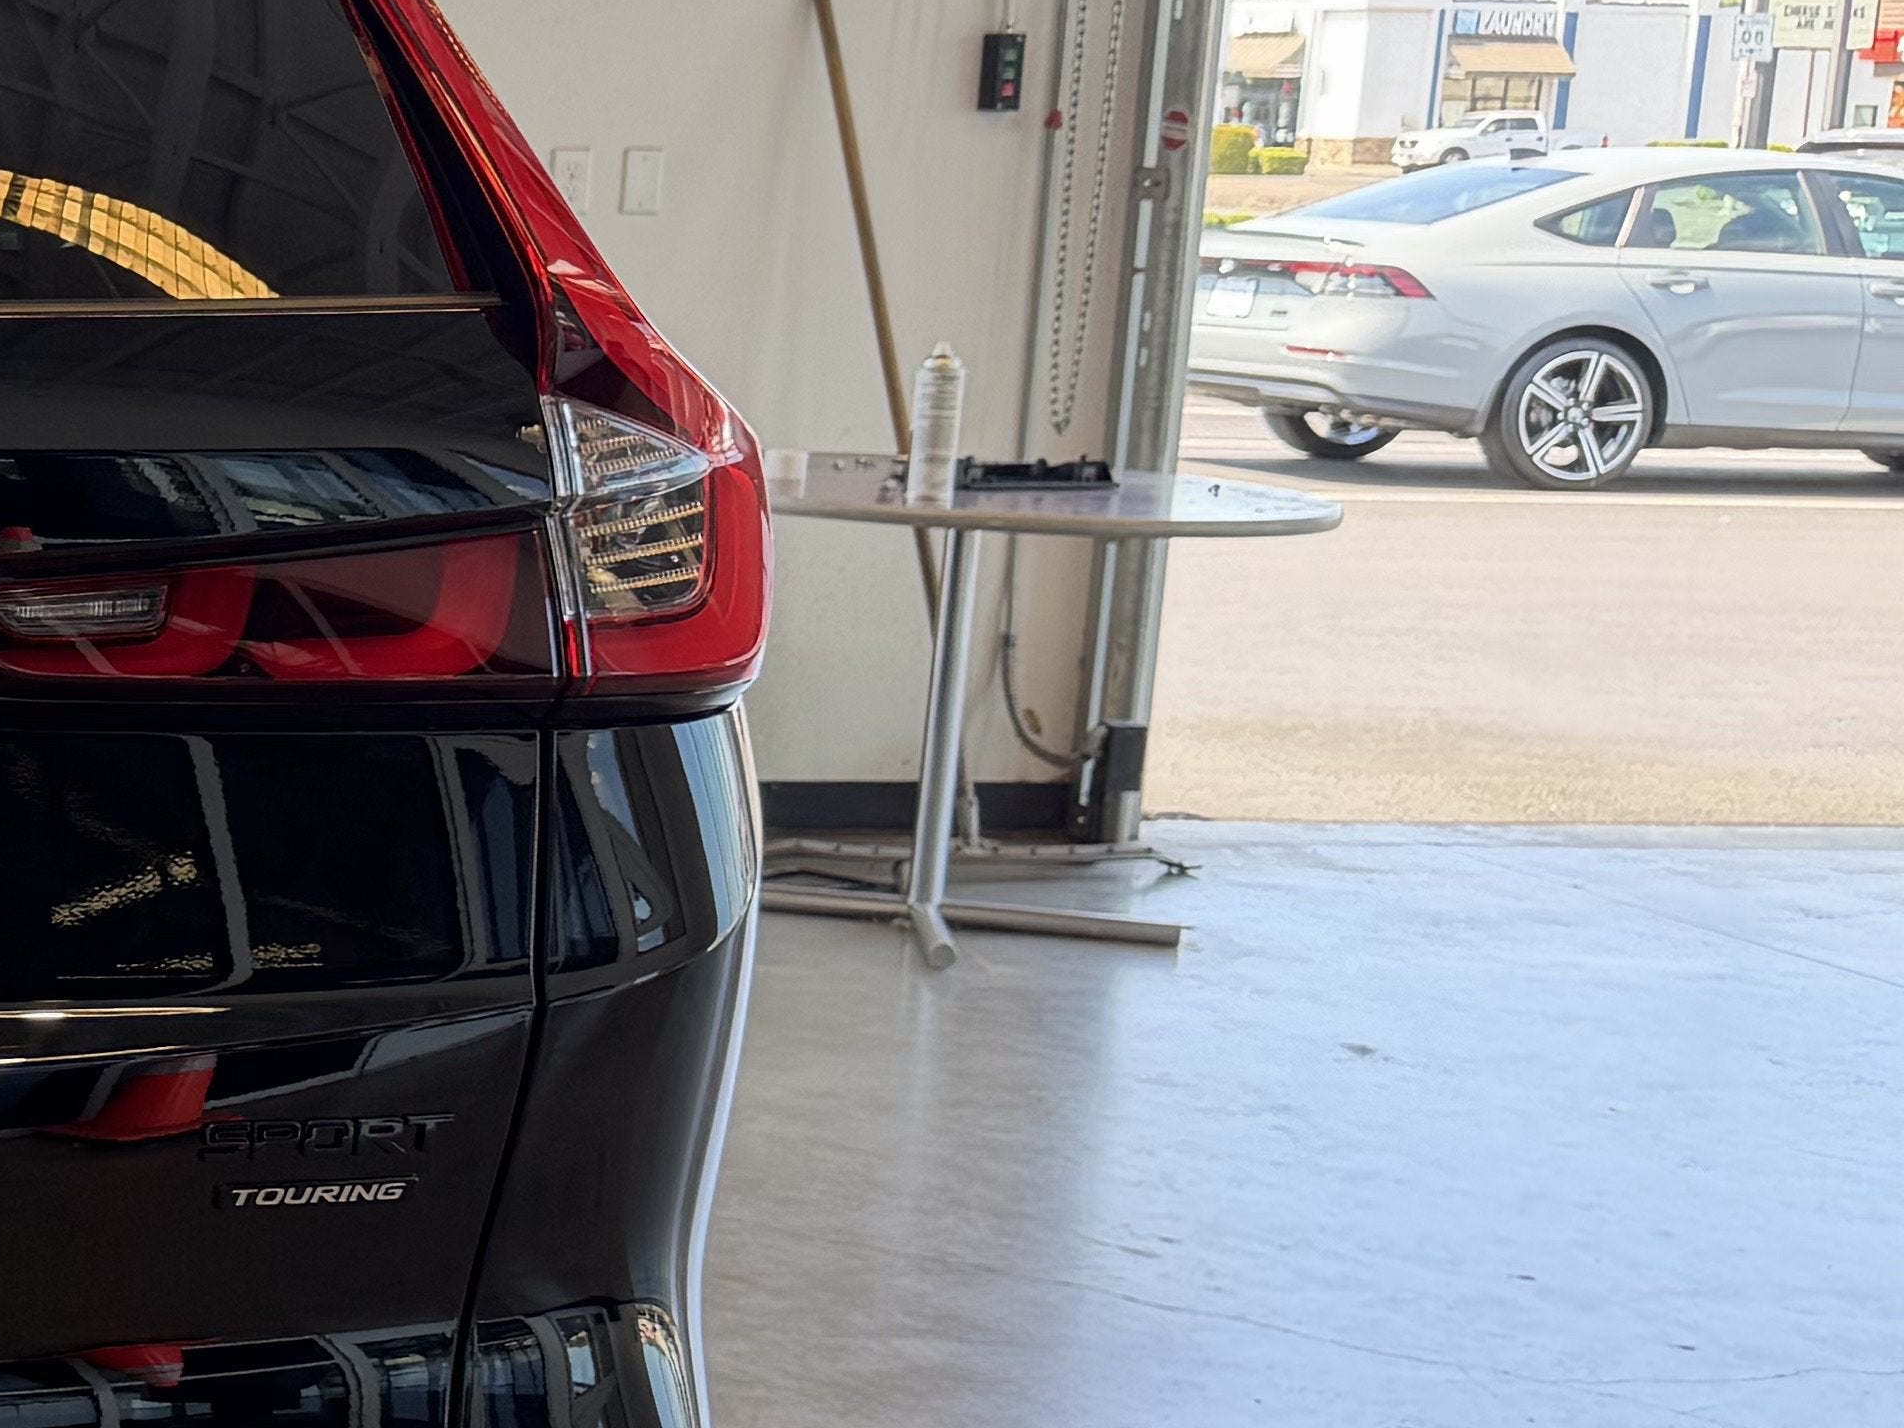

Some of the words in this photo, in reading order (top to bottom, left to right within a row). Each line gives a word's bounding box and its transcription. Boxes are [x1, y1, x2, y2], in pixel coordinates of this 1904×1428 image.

[1478, 10, 1556, 37] LAUNDRY
[198, 1112, 456, 1159] SPORT
[232, 1182, 407, 1207] TOURING
